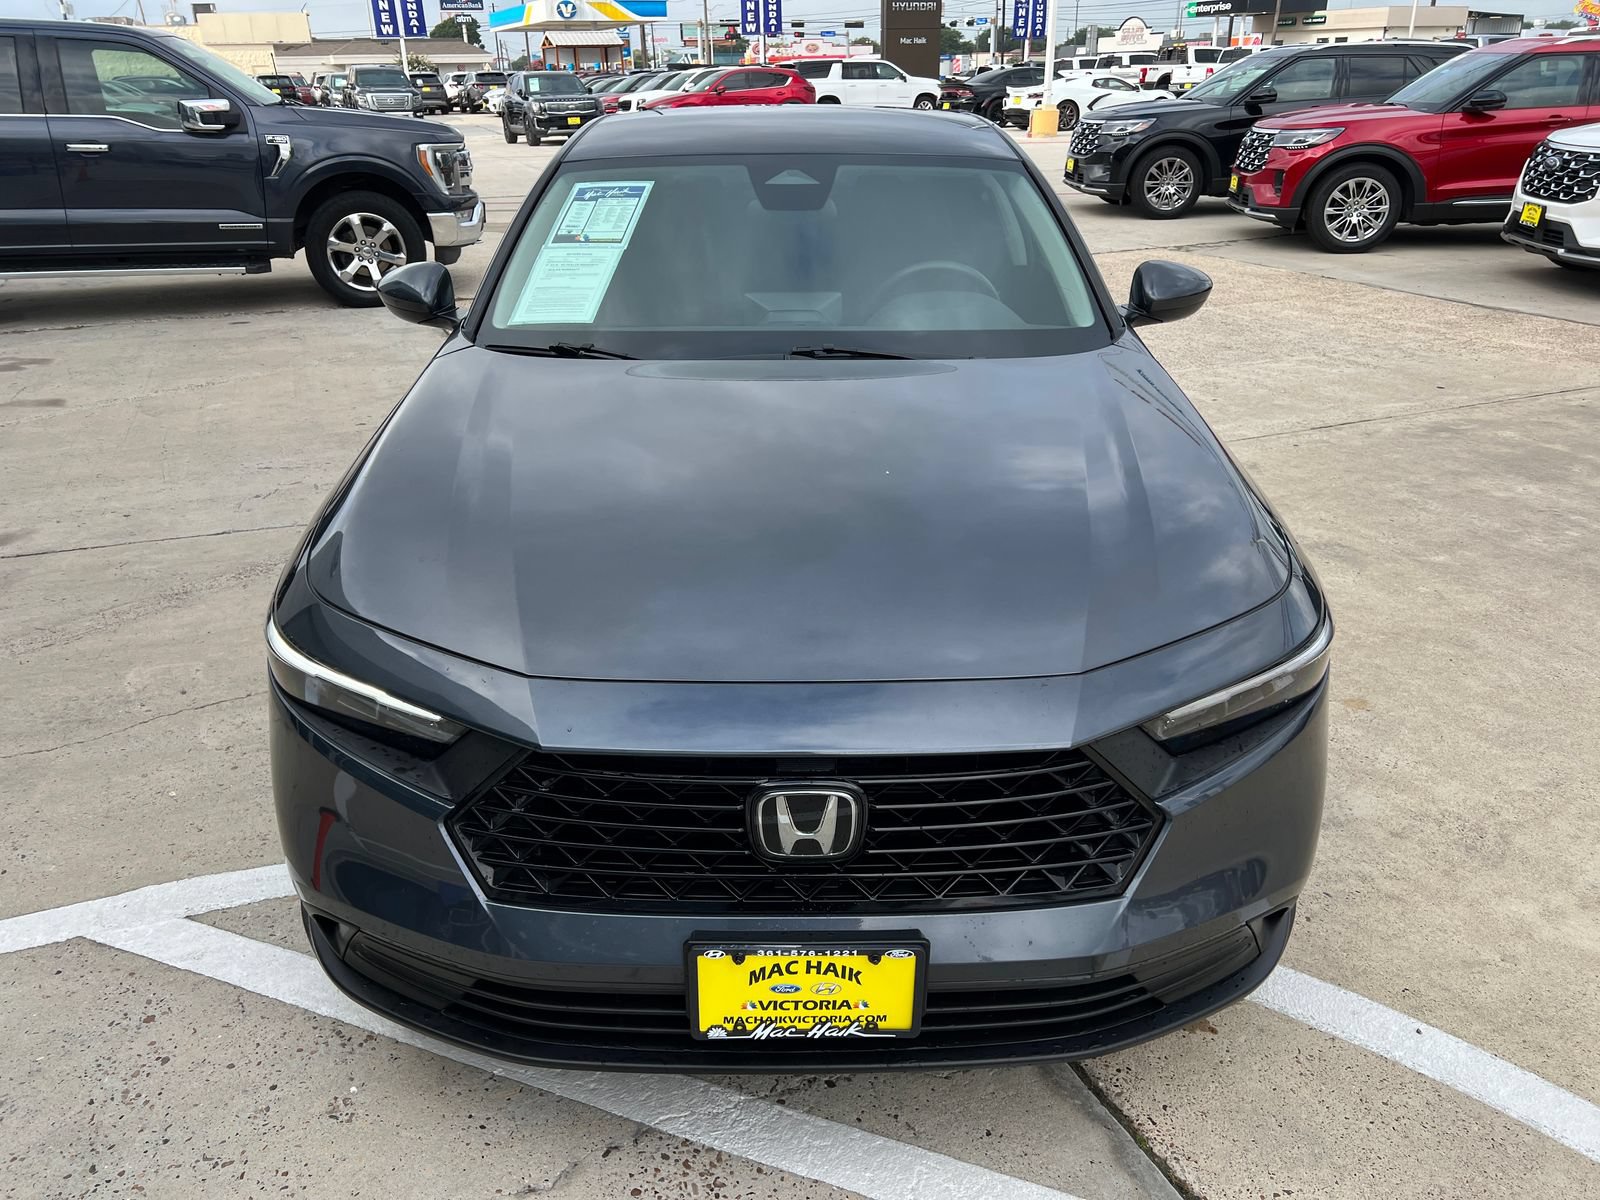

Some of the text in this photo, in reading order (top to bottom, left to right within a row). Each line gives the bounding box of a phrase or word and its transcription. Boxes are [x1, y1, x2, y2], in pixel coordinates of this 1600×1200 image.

[892, 1, 937, 11] HYUNDAI
[1189, 2, 1232, 13] enterprise
[455, 15, 472, 23] atm
[745, 1, 757, 33] NEW
[1015, 7, 1026, 37] NEW
[913, 36, 927, 44] Haik
[748, 960, 863, 986] MAC HAIK
[757, 999, 853, 1011] VICTORIA
[750, 1021, 868, 1040] Mac Haik
